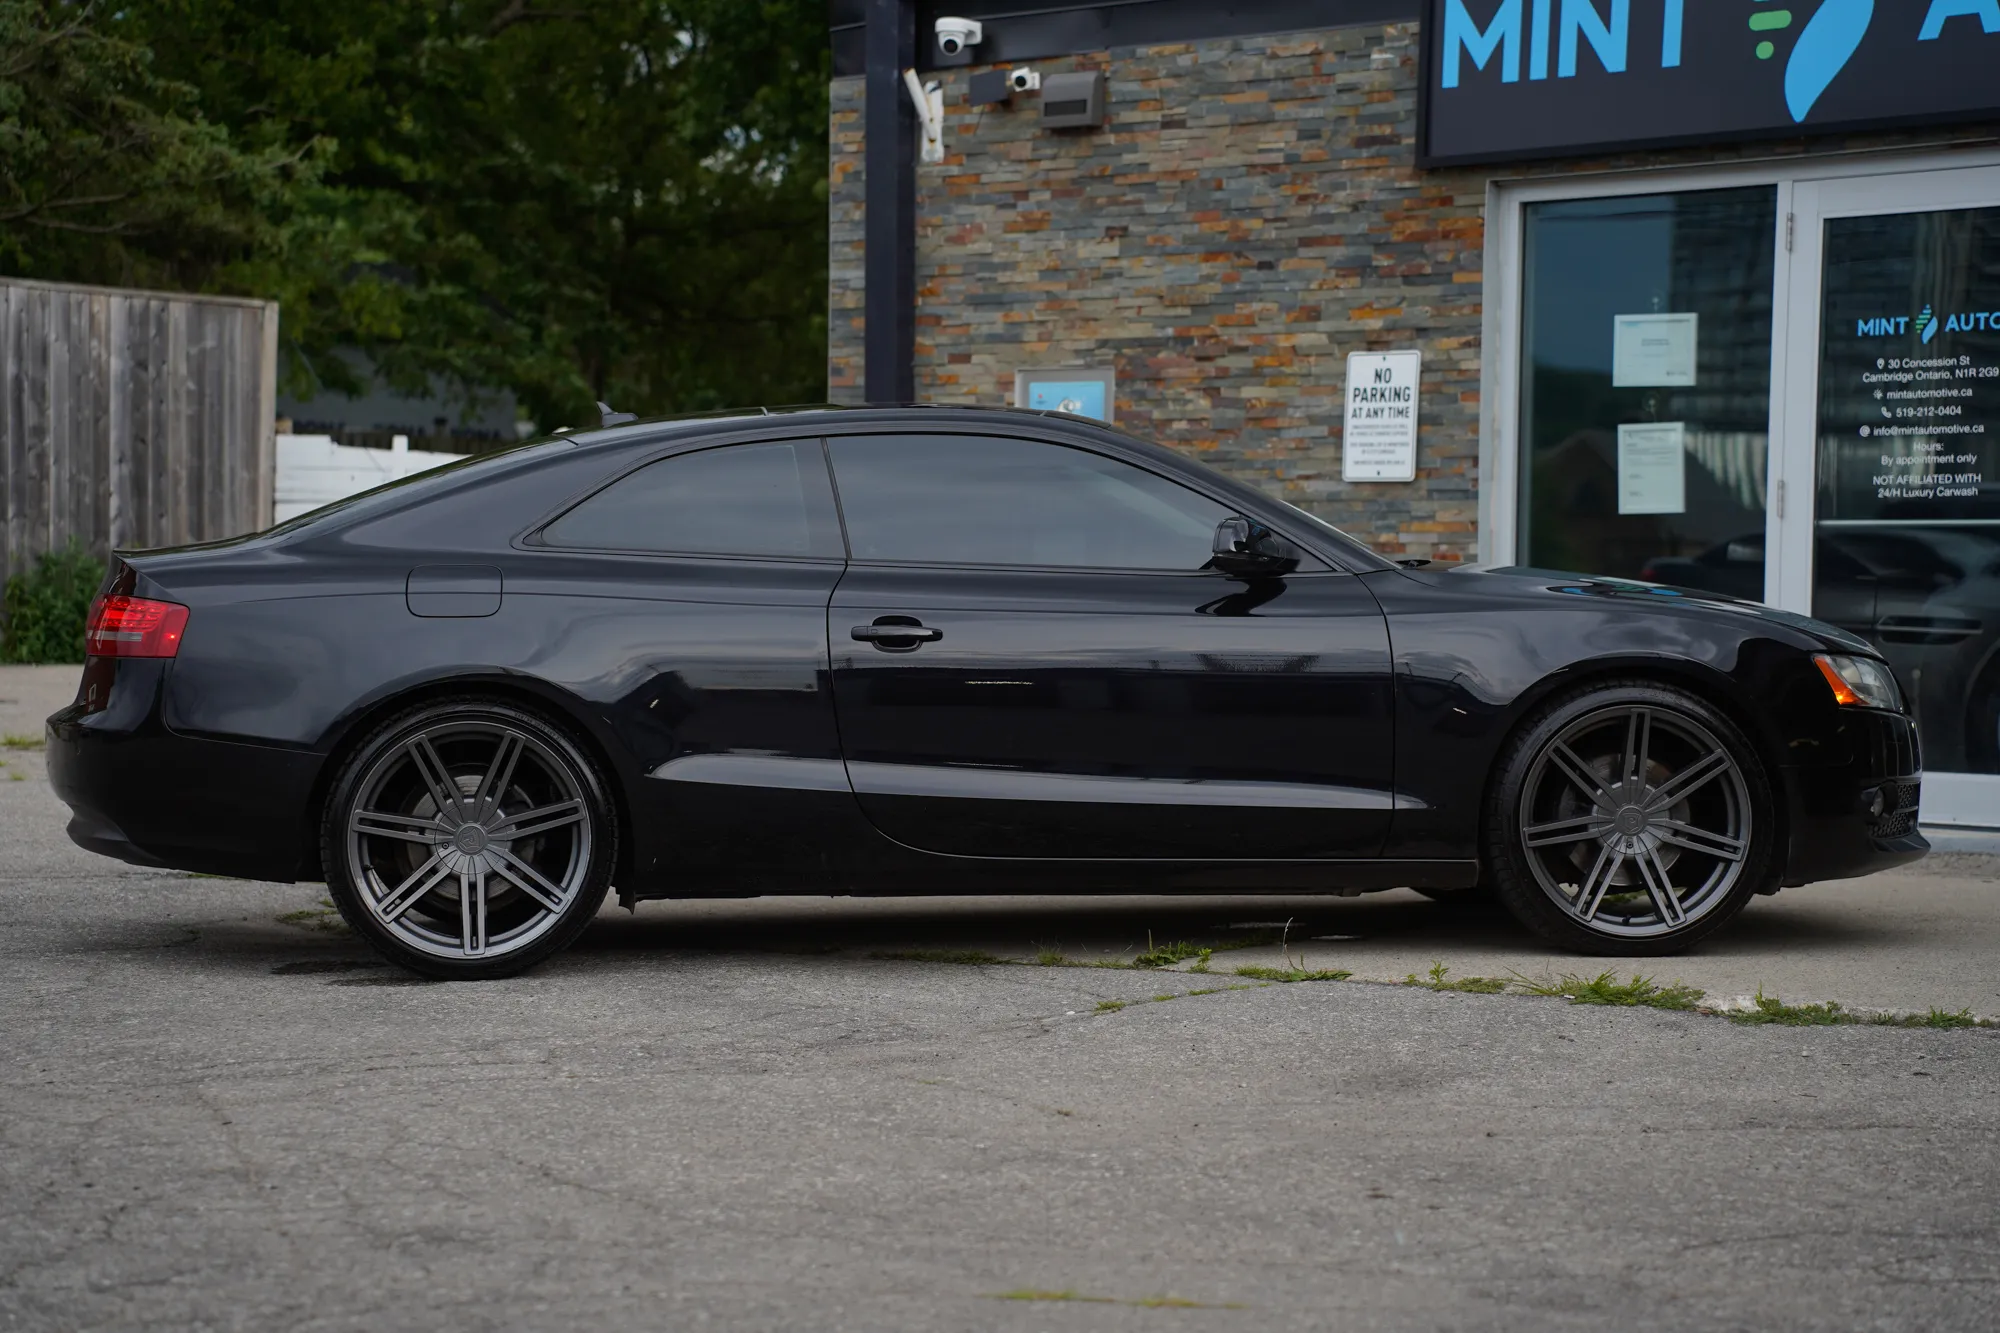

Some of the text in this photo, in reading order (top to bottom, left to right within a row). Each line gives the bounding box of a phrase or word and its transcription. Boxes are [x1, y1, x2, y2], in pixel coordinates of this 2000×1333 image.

[1857, 317, 1909, 336] MINT
[1888, 355, 1970, 369] 30 Concession St
[1374, 368, 1392, 384] NO
[1862, 366, 1999, 383] Cambridge Ontario, N1R 2G9
[1353, 386, 1411, 403] PARKING
[1887, 388, 1973, 399] mintautomotive.ca
[1351, 406, 1410, 419] AT ANY TIME
[1896, 405, 1962, 417] 519-212-0404
[1873, 424, 1985, 436] info@mintautomotive.ca
[1913, 442, 1944, 451] Hours:
[1881, 453, 1977, 467] By appointment only
[1872, 473, 1981, 485] NOT AFFILIATED WITH
[1878, 486, 1978, 499] 24/H Luxury Carwash
